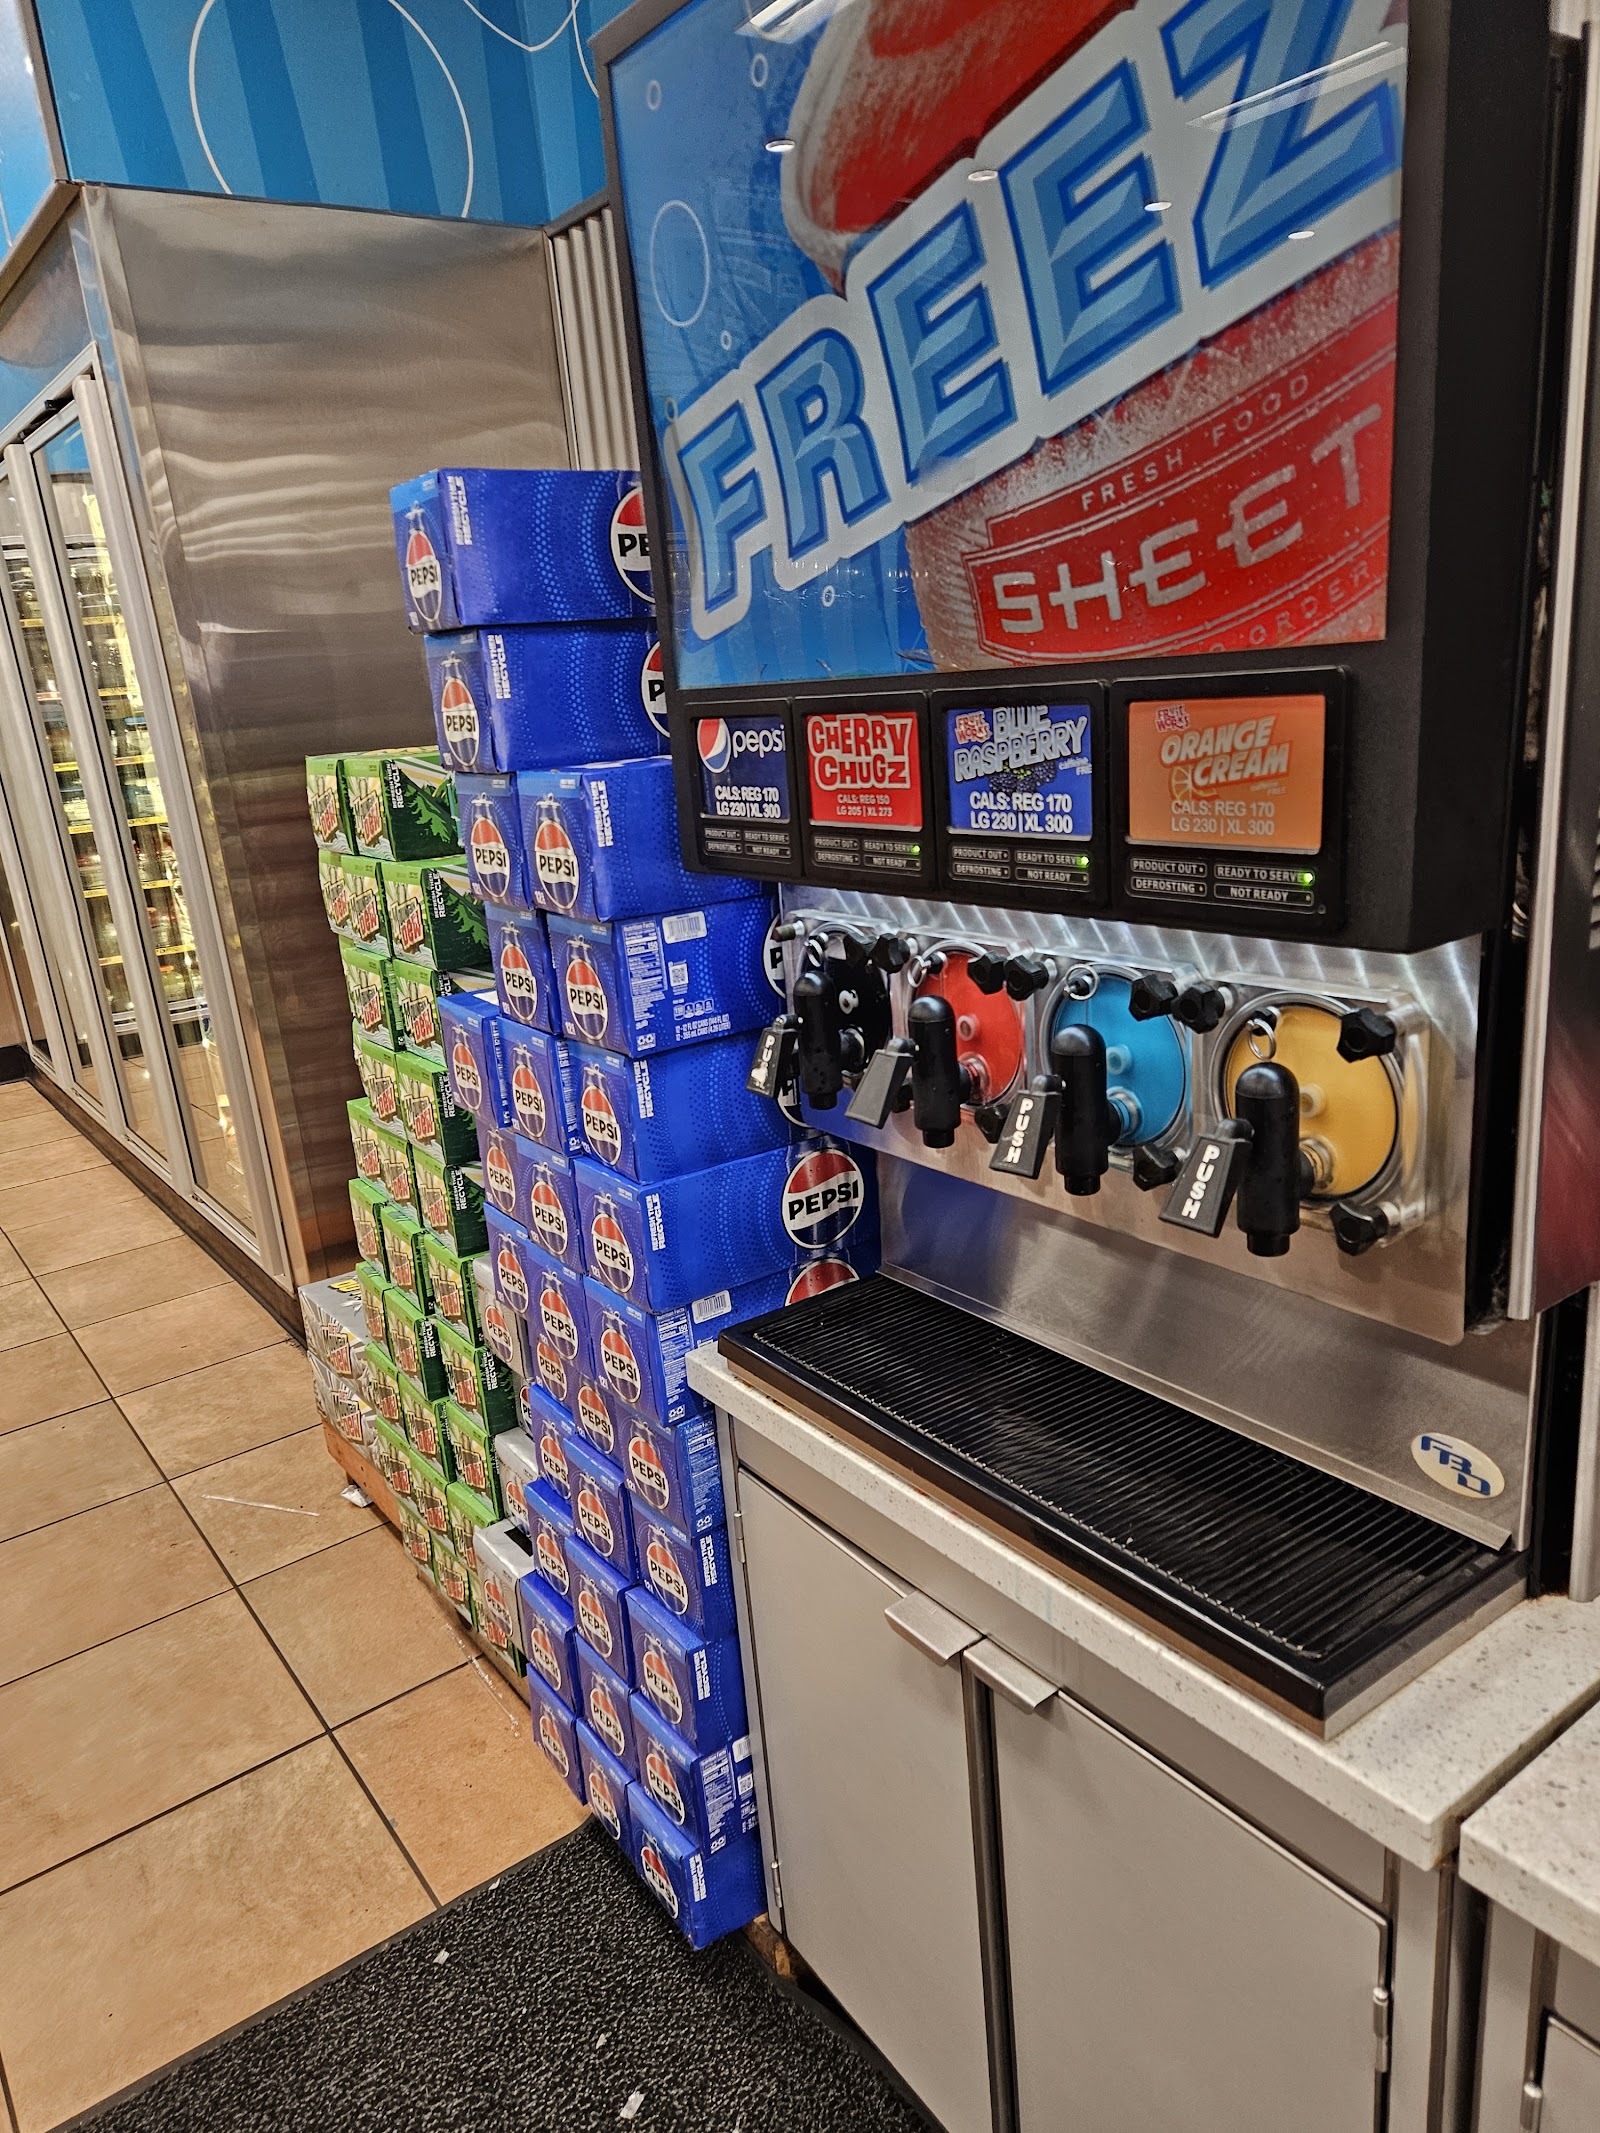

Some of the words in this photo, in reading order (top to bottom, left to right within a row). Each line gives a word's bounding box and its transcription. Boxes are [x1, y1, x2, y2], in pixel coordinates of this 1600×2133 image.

[1080, 448, 1184, 511] FRESH
[1211, 371, 1311, 448] FOOD
[991, 405, 1383, 634] SHEET
[410, 565, 438, 586] PEPSI
[1250, 560, 1370, 645] ORDER
[446, 714, 476, 732] PEPSI
[809, 715, 911, 758] CHERRY
[993, 705, 1051, 740] BLUE
[732, 724, 786, 758] pepsi
[954, 716, 1088, 782] RASPBERRY
[1161, 715, 1276, 764] ORANGE
[815, 754, 909, 788] CHUGZ
[1193, 742, 1290, 787] CREAM
[391, 763, 404, 808] RECYCLE
[715, 786, 741, 800] CALS:
[741, 786, 761, 801] REG
[762, 787, 779, 802] 170
[859, 794, 876, 804] REG
[716, 801, 729, 815] LG
[729, 802, 746, 816] 230
[751, 803, 763, 817] XL
[763, 803, 781, 819] 300
[836, 805, 847, 816] LG
[969, 791, 1010, 810] CALS:
[1011, 792, 1045, 812] REG
[1046, 793, 1073, 813] 170
[1171, 800, 1211, 816] CALS:
[1215, 801, 1246, 817] REG
[1250, 801, 1275, 818] 170
[970, 811, 990, 829] LG
[991, 812, 1017, 830] 230
[1024, 813, 1044, 832] XL
[1045, 814, 1073, 834] 300
[1171, 816, 1190, 832] LG
[1192, 817, 1218, 834] 230
[1227, 818, 1245, 836] XL
[1247, 820, 1275, 837] 300
[475, 848, 507, 868] PEPSI
[539, 854, 575, 877] PEPSI
[953, 848, 987, 859] PRODUCT
[987, 850, 1003, 860] OUT
[1017, 852, 1043, 863] READY
[1044, 854, 1055, 863] TO
[1133, 860, 1177, 873] PRODUCT
[1178, 864, 1198, 875] OUT
[956, 865, 1002, 877] DEFROSTING
[1027, 870, 1043, 880] NOT
[1044, 871, 1071, 882] READY
[1135, 879, 1196, 893] DEFROSTING
[1217, 866, 1250, 879] READY
[1253, 868, 1268, 880] TO
[1269, 870, 1303, 883] SERVE
[433, 871, 446, 918] RECYCLE
[1230, 887, 1251, 898] NOT
[1252, 888, 1289, 902] READY
[505, 970, 535, 996] PEPSI
[570, 988, 605, 1012] PEPSI
[456, 1064, 479, 1087] PEPSI
[751, 1035, 775, 1089] PU
[444, 1075, 455, 1117] RECYCLE
[515, 1089, 543, 1112] PEPSI
[639, 1060, 654, 1118] RECYCLE
[585, 1113, 618, 1141] PEPSI
[1006, 1098, 1034, 1164] PUSH
[456, 1170, 467, 1209] RECYCLE
[489, 1168, 513, 1192] PEPSI
[1181, 1144, 1220, 1219] PUSH
[788, 1182, 859, 1221] PEPSI
[535, 1205, 565, 1233] PEPSI
[652, 1193, 666, 1250] RECYCLE
[596, 1239, 631, 1270] PEPSI
[501, 1270, 526, 1294] PEPSI
[425, 1320, 437, 1357] RECYCLE
[488, 1320, 511, 1346] PEPSI
[544, 1311, 576, 1341] PEPSI
[679, 1324, 688, 1332] 150
[540, 1356, 565, 1384] PEPSI
[604, 1351, 638, 1382] PEPSI
[581, 1405, 611, 1436] PEPSI
[544, 1453, 567, 1482] PEPS
[632, 1457, 667, 1490] PEPSI
[508, 1495, 527, 1517] PEPS
[581, 1508, 610, 1540] PEPSI
[540, 1551, 567, 1581] PEPSI
[650, 1560, 685, 1597] PEPSI
[582, 1607, 610, 1641] PEPSI
[647, 1667, 679, 1707] PEPSI
[593, 1705, 622, 1740] PEPSI
[650, 1772, 683, 1815] PEPSI
[592, 1787, 619, 1832] PEPSI
[644, 1860, 676, 1907] PEPSI
